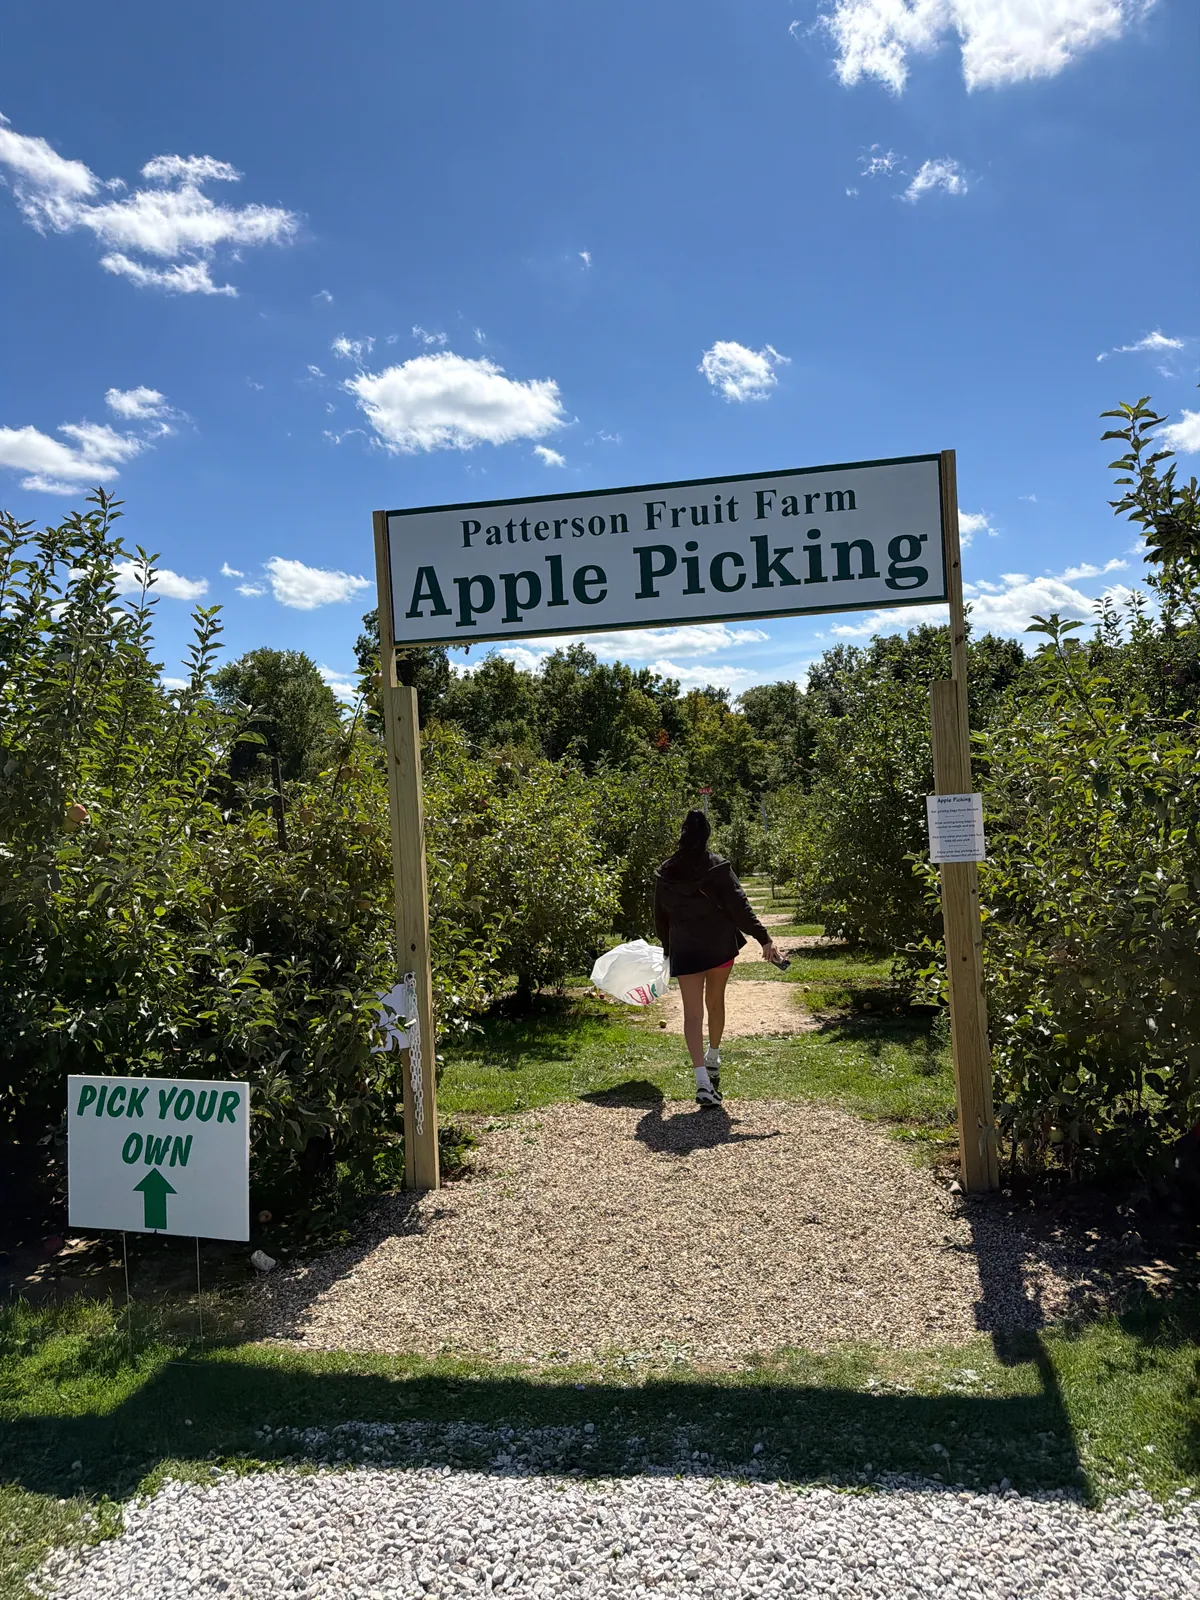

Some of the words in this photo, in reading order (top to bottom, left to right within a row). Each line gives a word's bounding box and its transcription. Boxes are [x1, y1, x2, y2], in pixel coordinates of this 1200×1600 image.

[460, 512, 629, 548] Patterson
[643, 494, 740, 531] Fruit
[754, 483, 858, 519] Farm
[406, 554, 609, 628] Apple
[633, 528, 929, 600] Picking
[77, 1085, 149, 1118] PICK
[158, 1086, 240, 1123] YOUR
[122, 1132, 193, 1167] OWN
